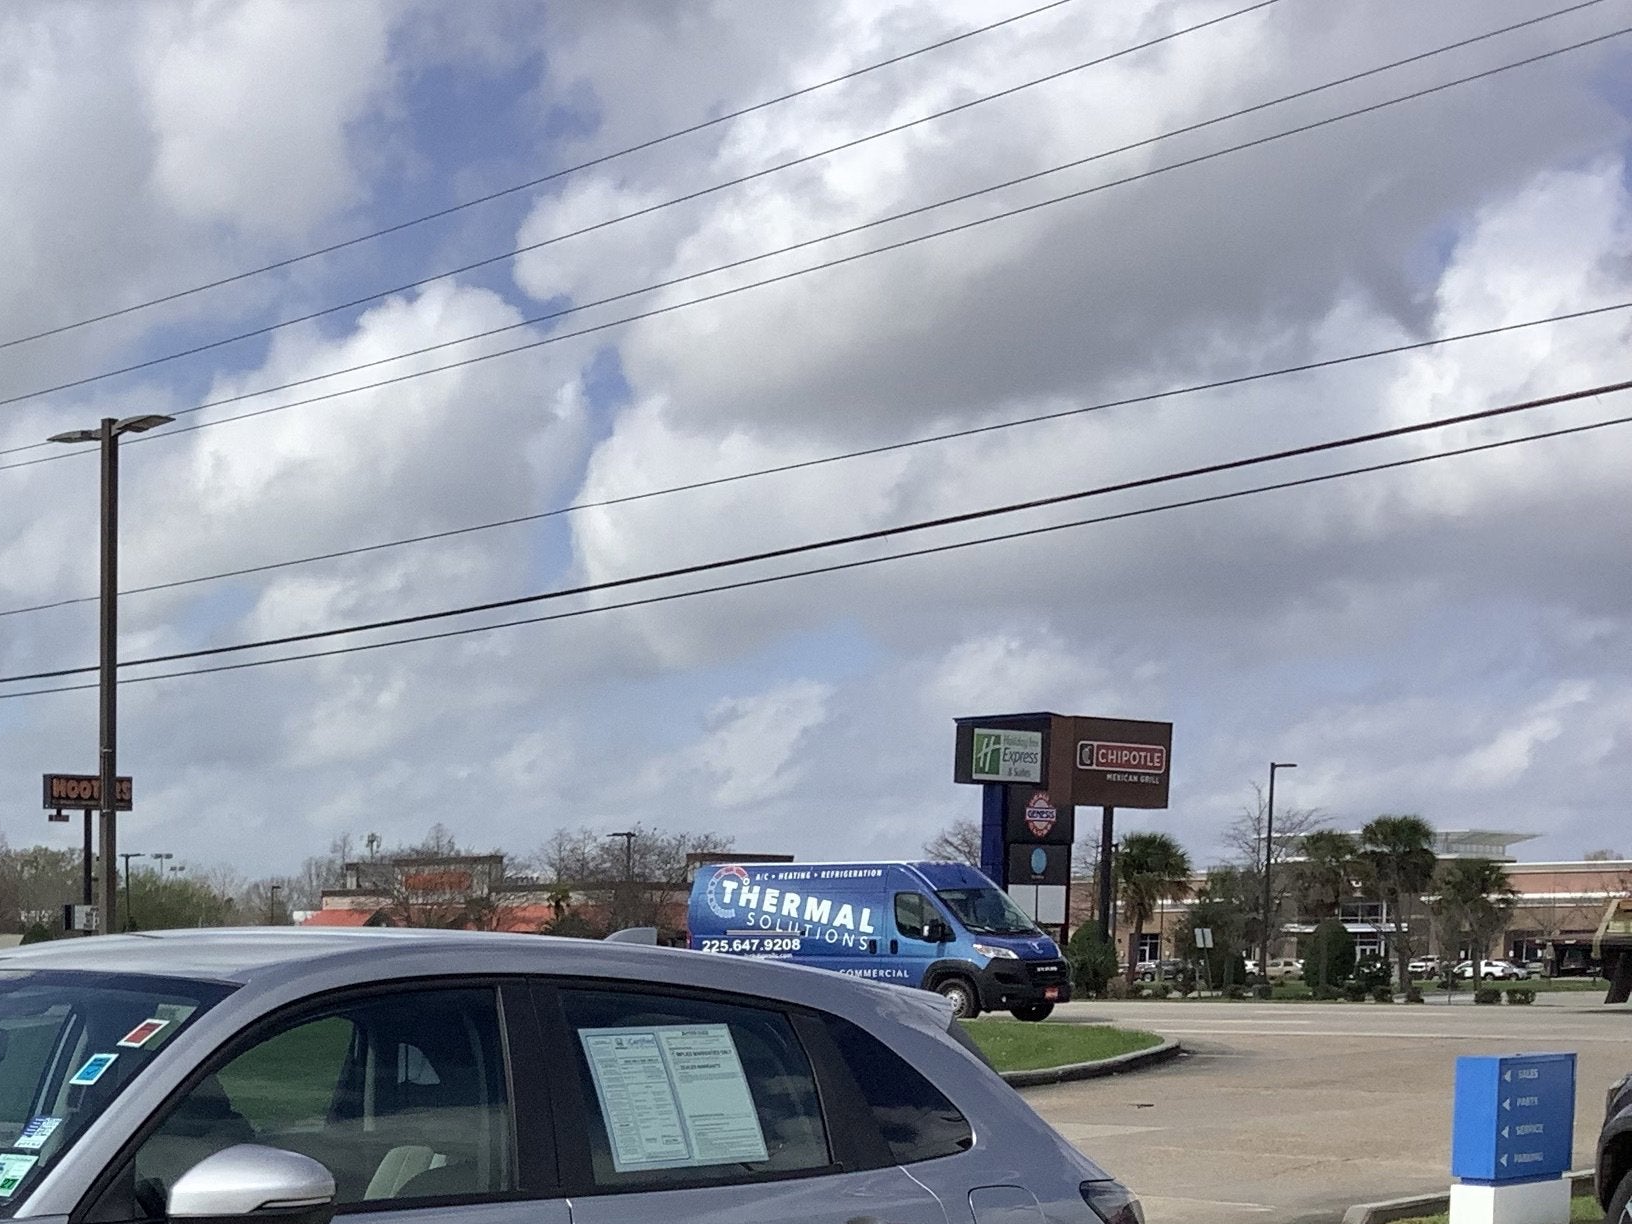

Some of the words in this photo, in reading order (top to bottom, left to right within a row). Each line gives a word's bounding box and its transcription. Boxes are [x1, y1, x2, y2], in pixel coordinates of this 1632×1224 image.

[1002, 747, 1039, 765] Express
[1098, 749, 1162, 767] CHIPOTLE
[1107, 773, 1139, 783] MEXICAN
[1140, 775, 1160, 784] GRILL
[1027, 810, 1055, 819] GENESIS
[756, 873, 768, 881] A/C
[778, 871, 811, 881] HEATING
[821, 869, 882, 879] REFRIGERATION
[722, 880, 874, 933] THERMAL
[702, 938, 801, 952] 225.647.9208
[839, 968, 910, 978] COMMERCIAL
[1518, 1068, 1538, 1079] SALES
[0, 1178, 19, 1189] 27
